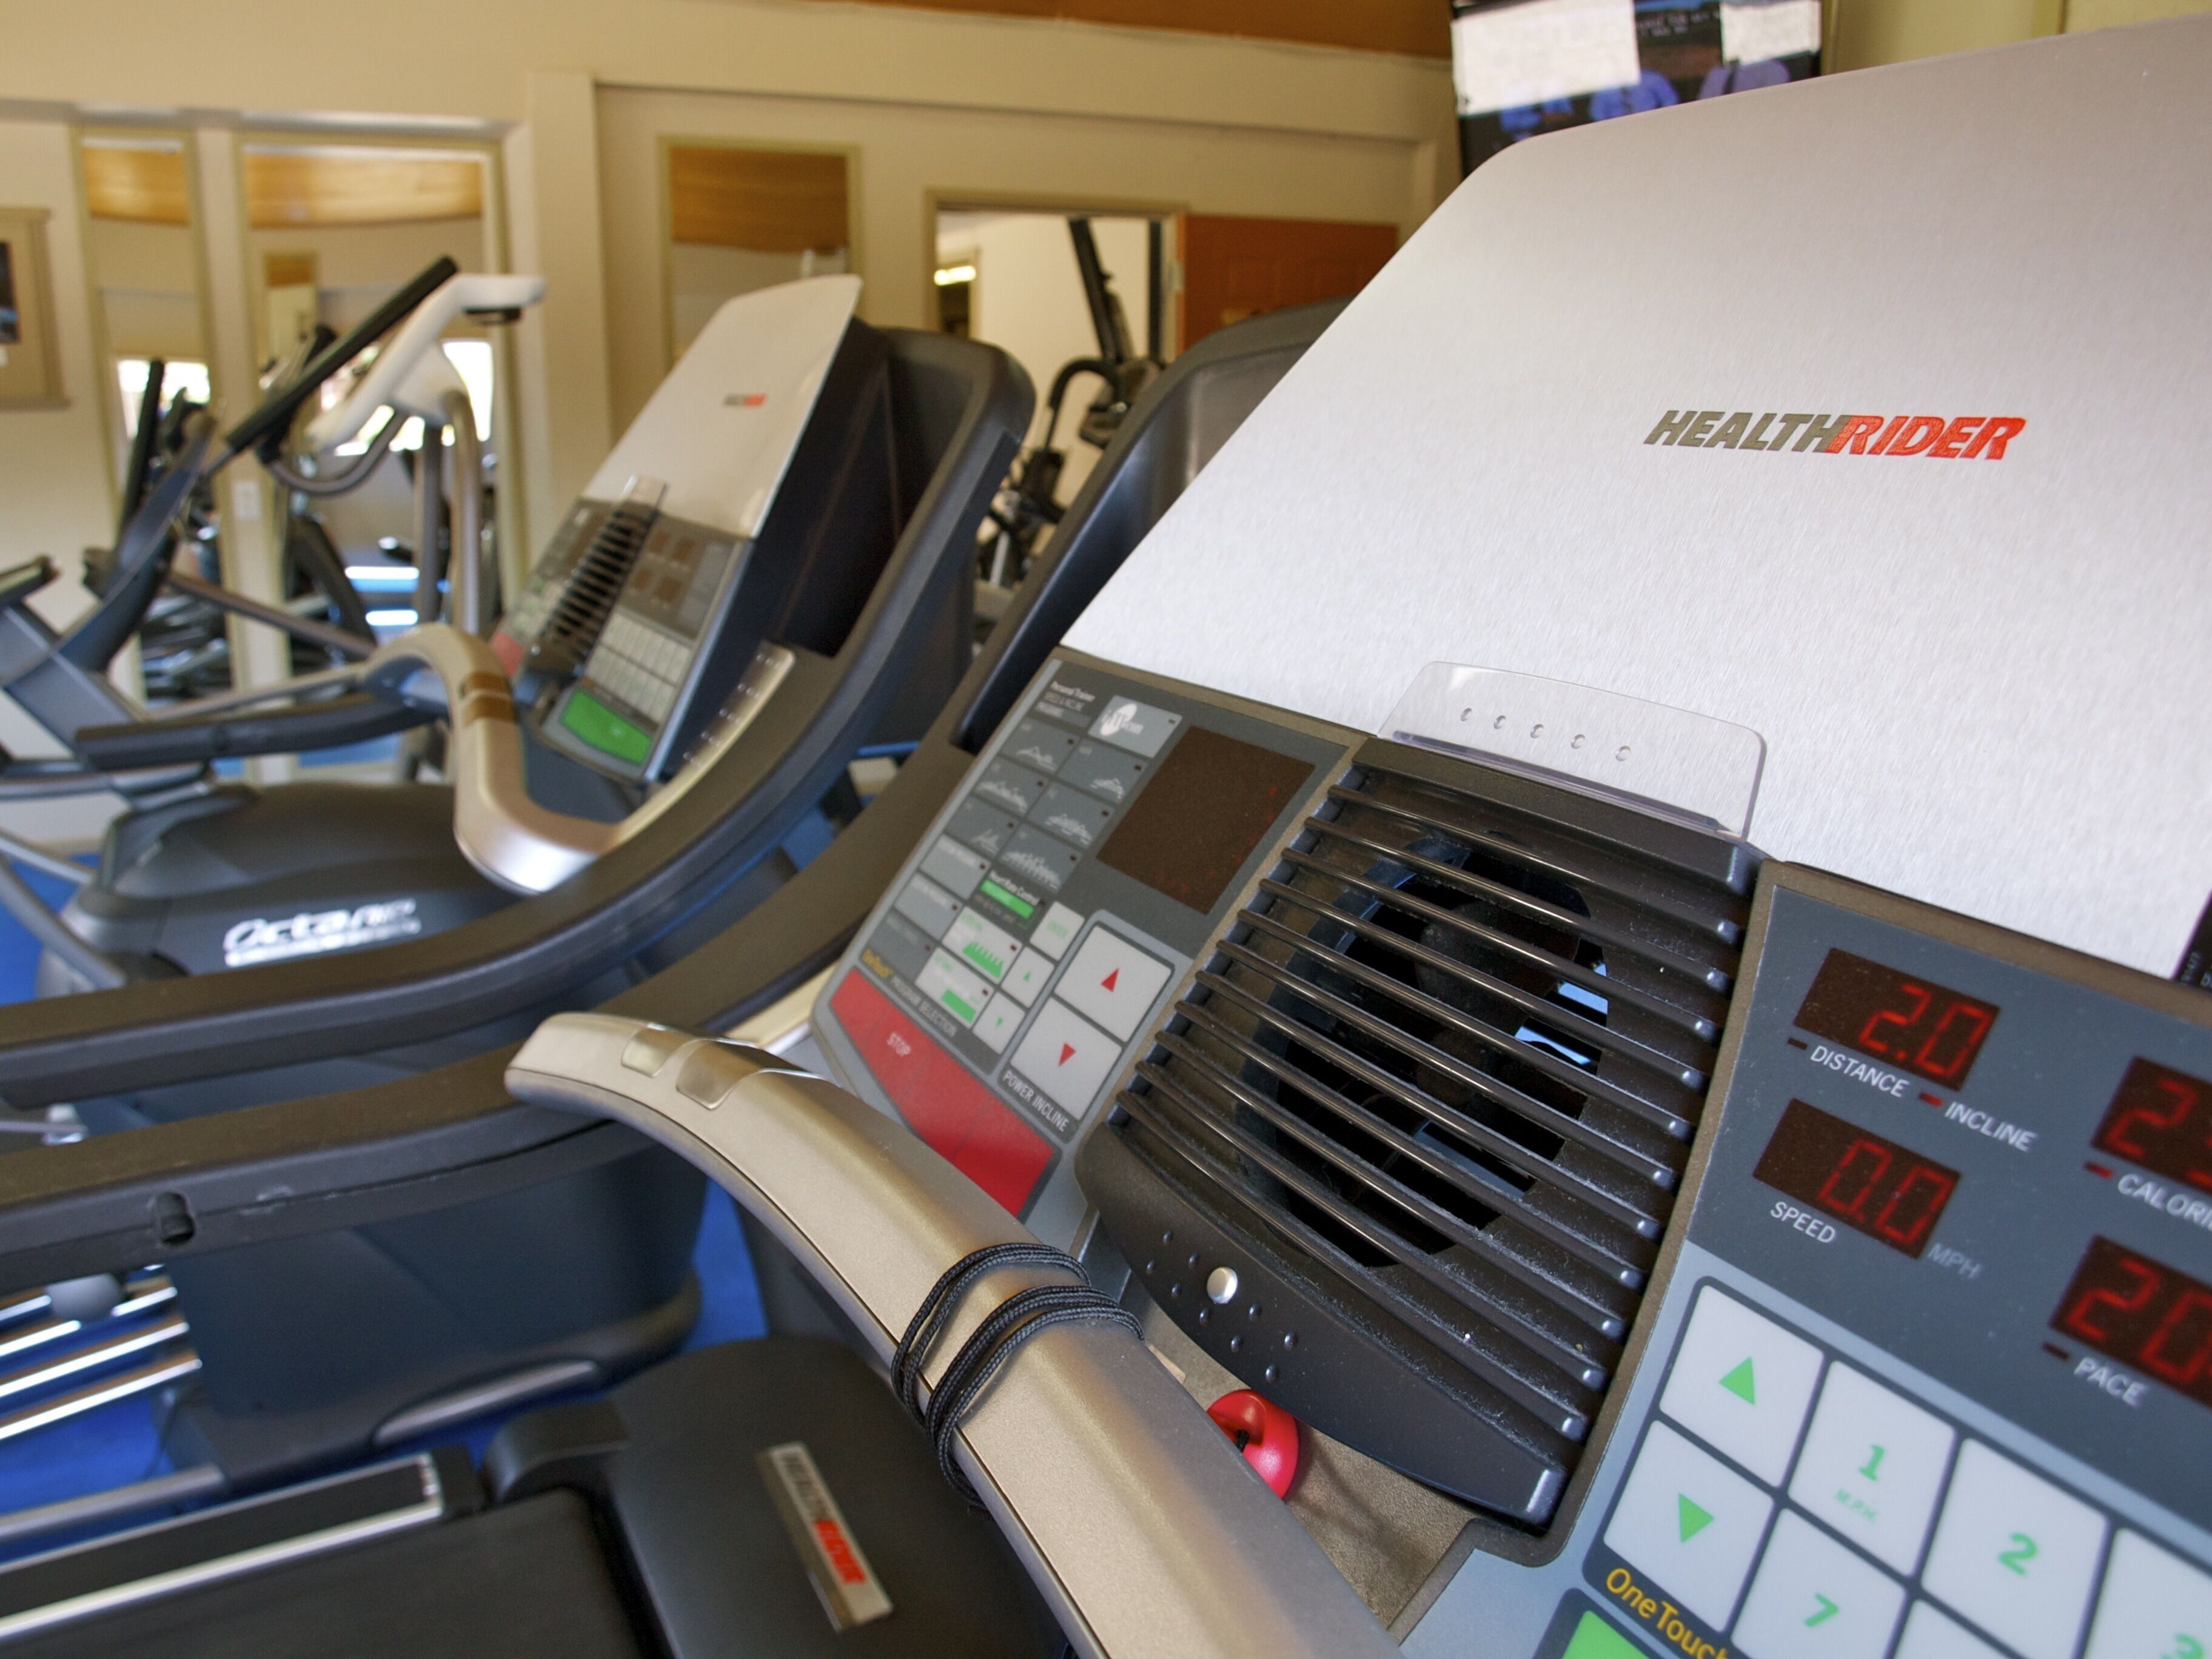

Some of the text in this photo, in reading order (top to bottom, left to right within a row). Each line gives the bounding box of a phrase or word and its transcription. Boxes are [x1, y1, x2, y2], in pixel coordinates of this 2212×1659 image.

[1643, 410, 2026, 460] HEALTHRIDER
[886, 1032, 911, 1057] STOP
[1858, 982, 1992, 1078] 2.0
[1810, 1045, 1911, 1098] DISTANCE
[1002, 1070, 1070, 1133] POWER INCLINE
[1945, 1101, 2039, 1152] INCLINE
[1769, 1201, 1837, 1244] SPEED
[2117, 1173, 2212, 1232] CALORI
[1926, 1242, 1982, 1279] MPH
[2073, 1357, 2149, 1407] PACE
[1857, 1444, 1885, 1482] 1
[1997, 1533, 2039, 1576] 2
[1802, 1593, 1839, 1629] 7
